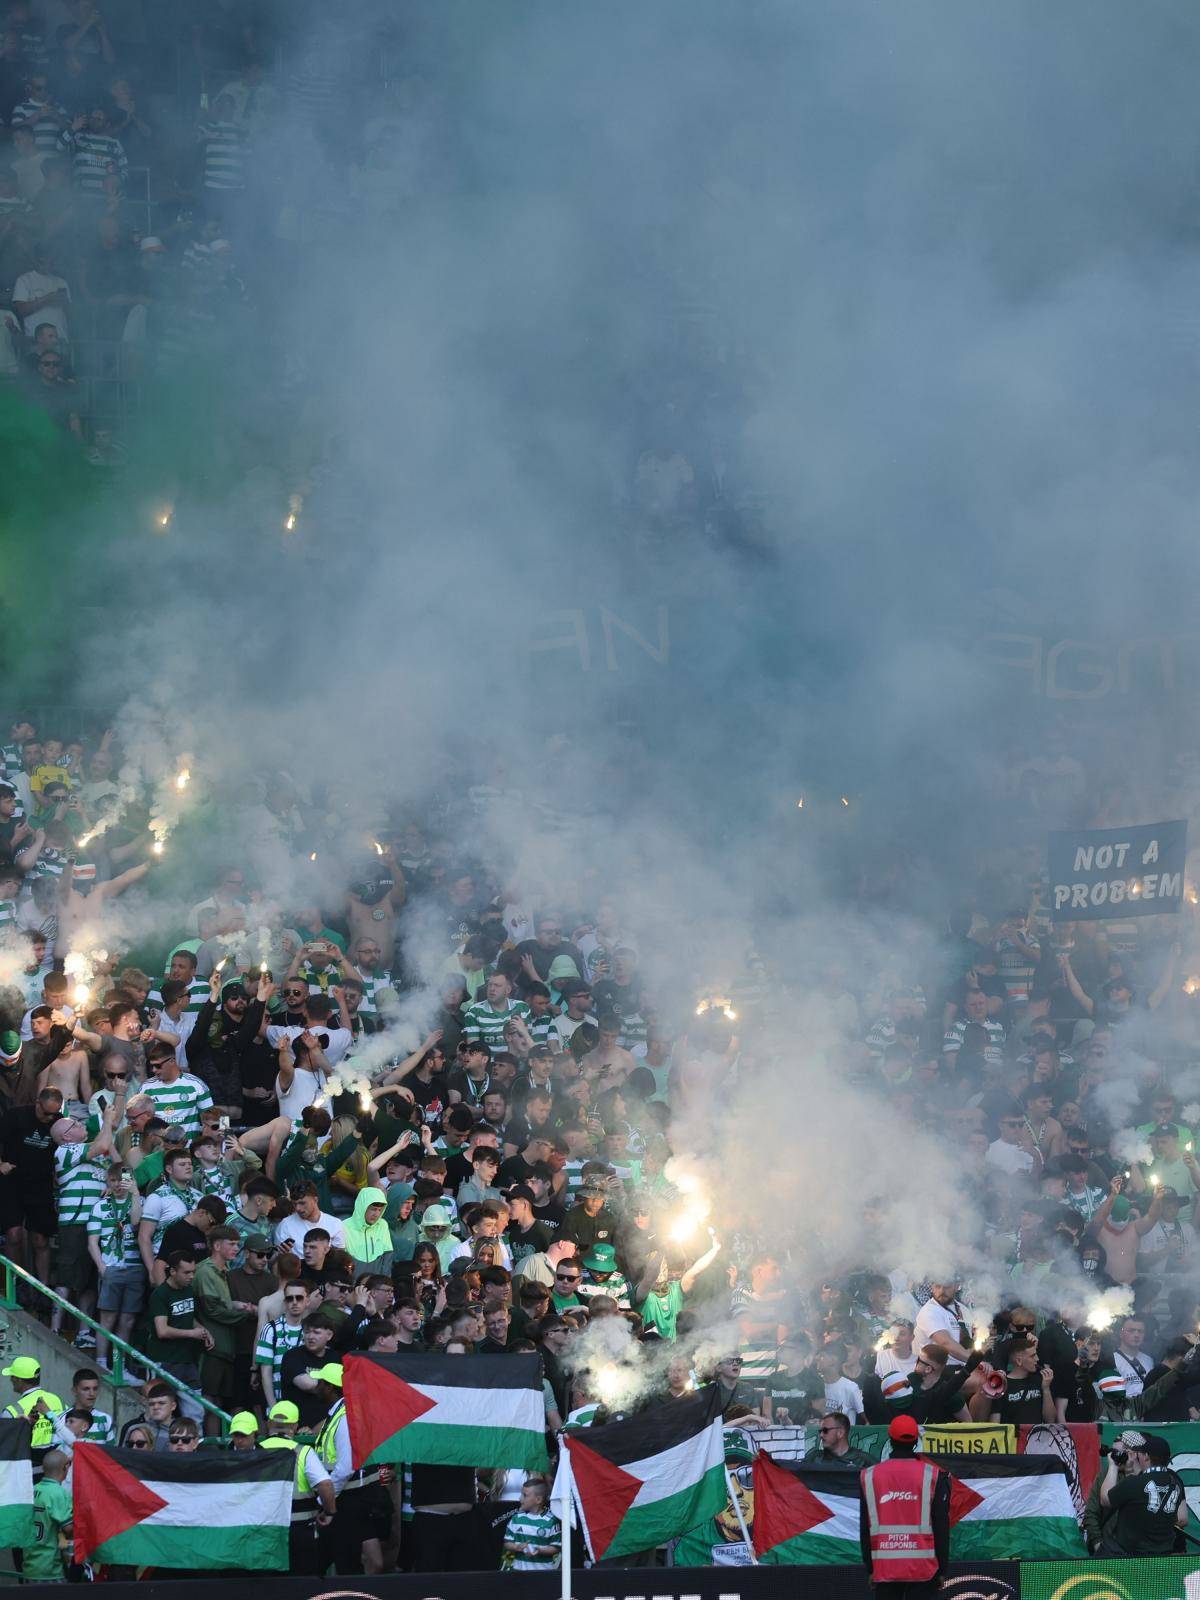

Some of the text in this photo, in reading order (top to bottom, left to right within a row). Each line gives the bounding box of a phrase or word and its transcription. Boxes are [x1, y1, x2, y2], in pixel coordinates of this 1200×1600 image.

[1073, 840, 1159, 872] NOT A
[1054, 873, 1181, 909] PROBLEM
[926, 1438, 1000, 1454] THIS IS A
[880, 1541, 918, 1549] RESPONSE
